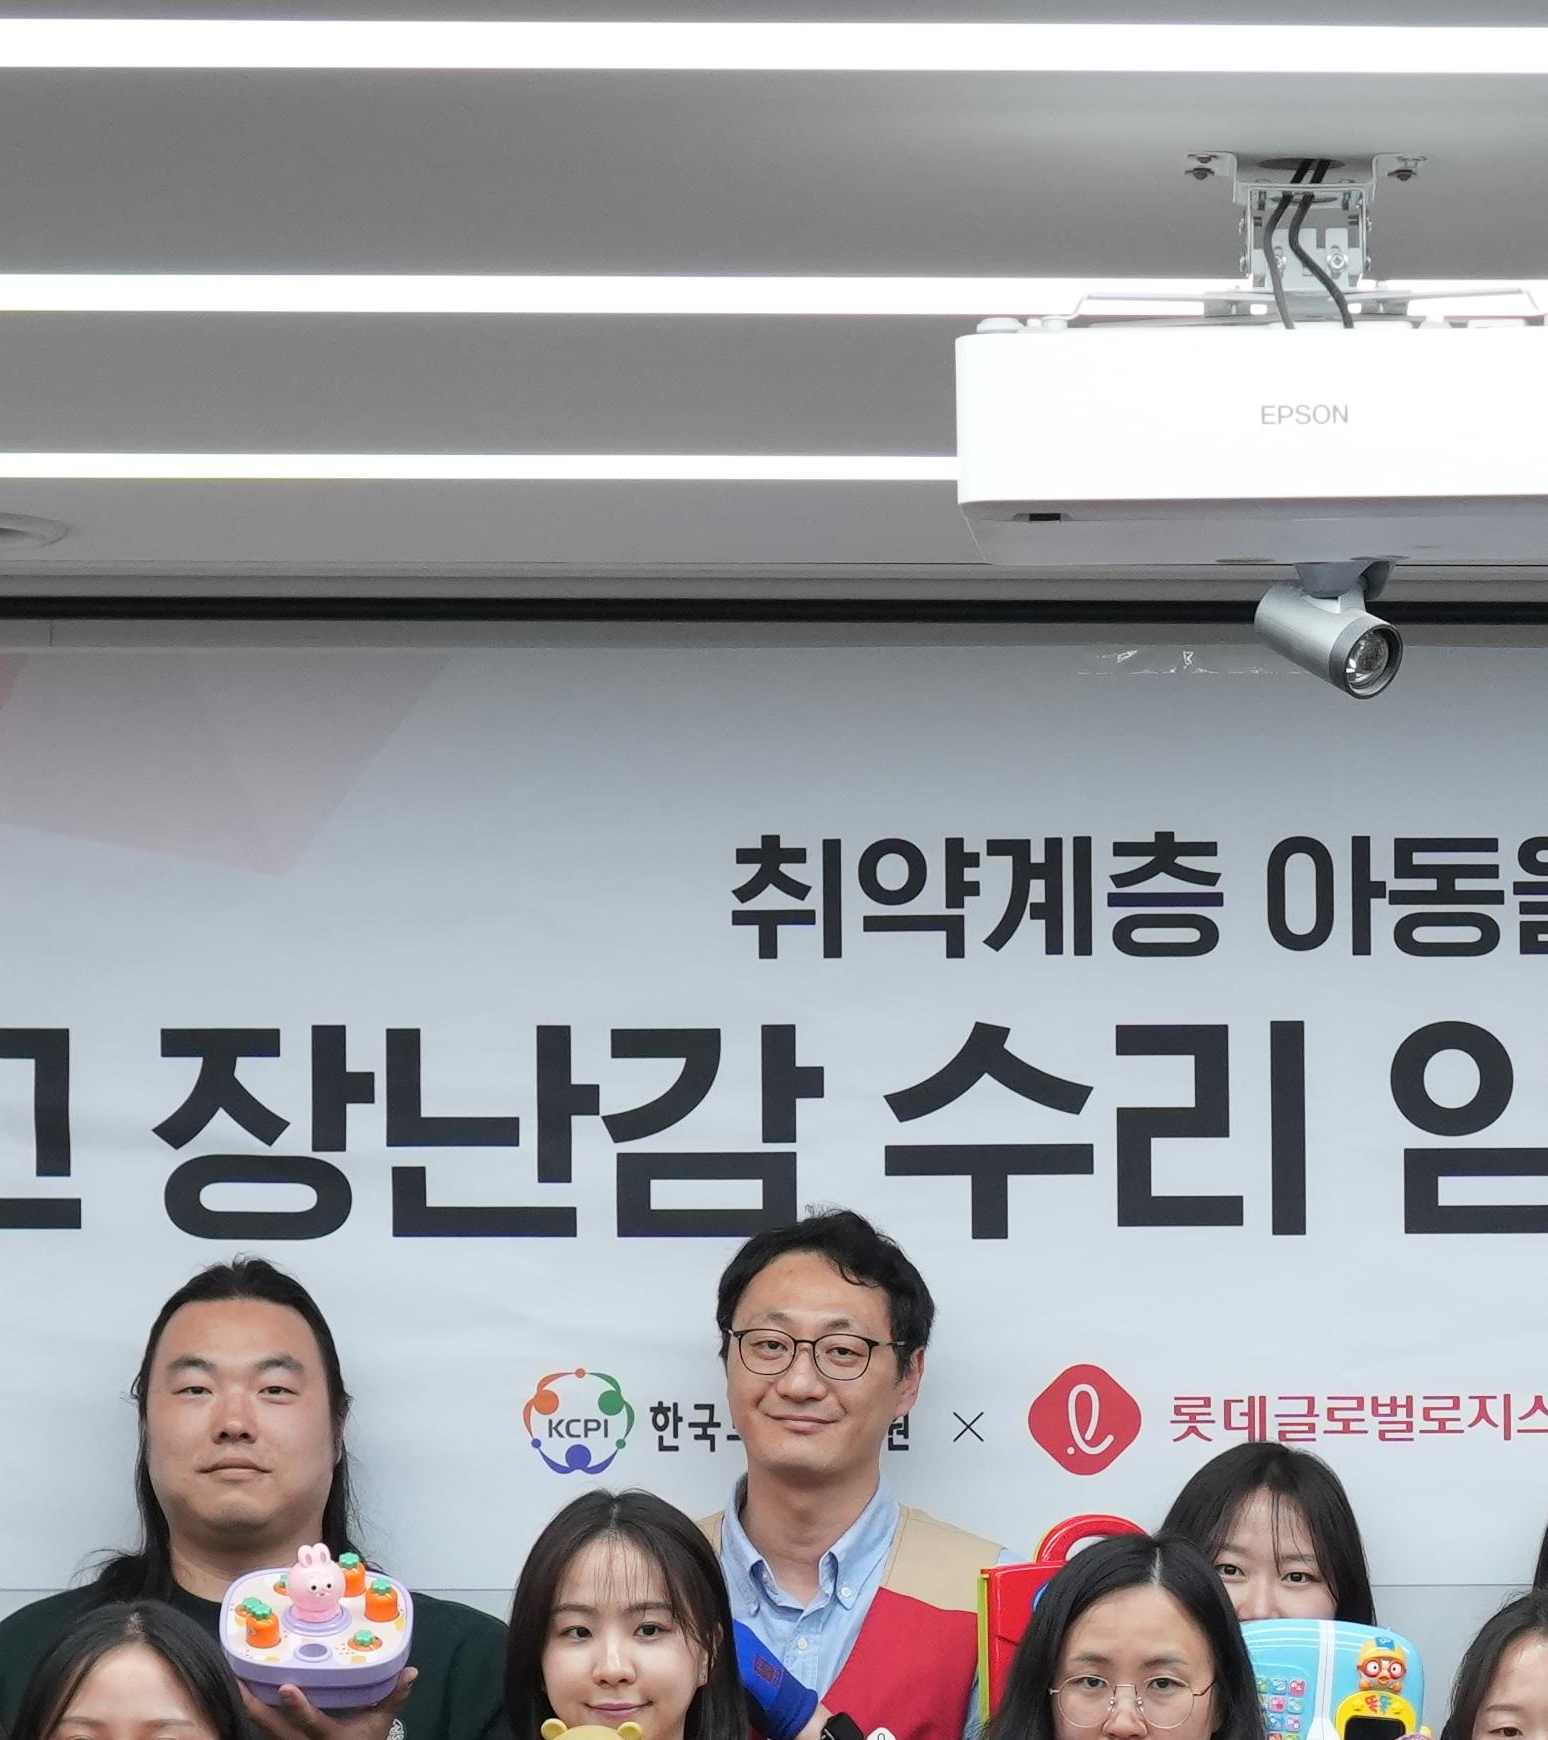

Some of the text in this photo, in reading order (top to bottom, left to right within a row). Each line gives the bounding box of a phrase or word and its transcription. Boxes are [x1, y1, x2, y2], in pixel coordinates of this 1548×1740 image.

[1260, 404, 1349, 425] EPSON
[732, 832, 1223, 959] 취약계층
[152, 1023, 825, 1239] 장난감
[883, 1020, 1306, 1239] 수리
[548, 1418, 609, 1439] KCPI
